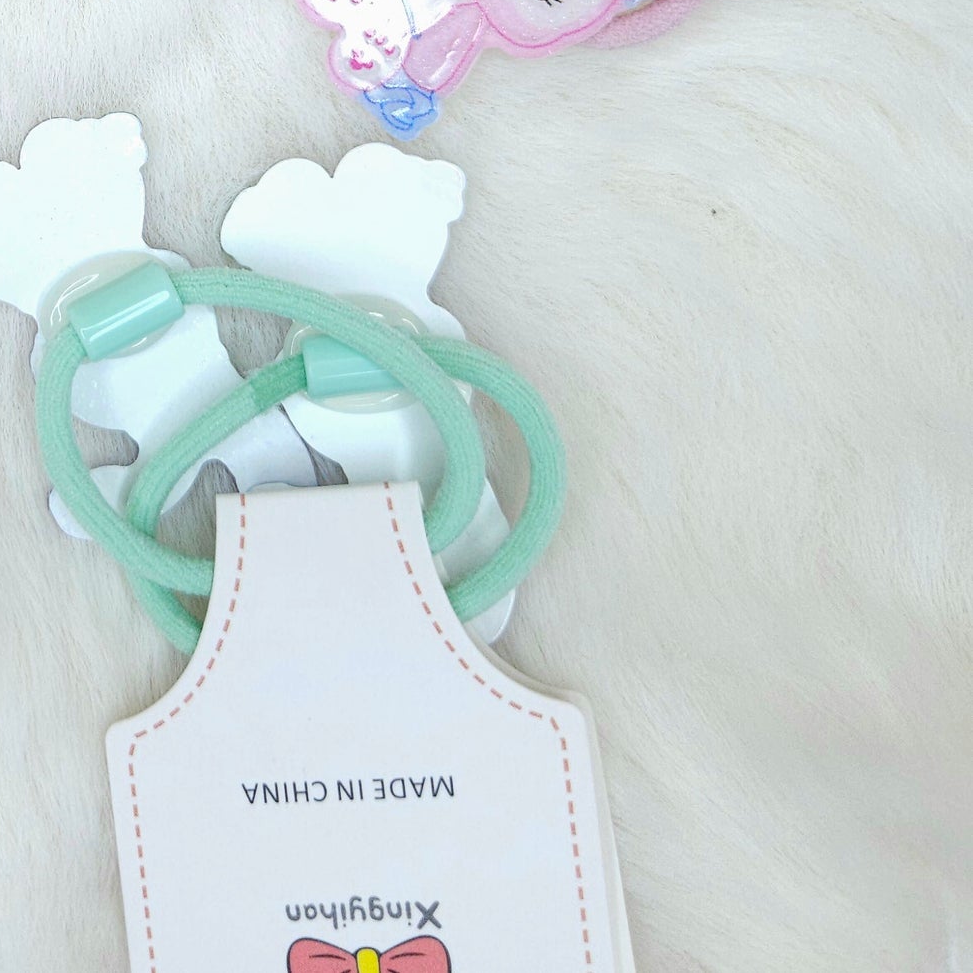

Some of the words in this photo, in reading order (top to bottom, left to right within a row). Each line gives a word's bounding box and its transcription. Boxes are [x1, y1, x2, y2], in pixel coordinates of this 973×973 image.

[241, 780, 328, 804] CHINA
[336, 779, 364, 801] IN
[372, 775, 455, 800] MADE
[285, 895, 442, 930] Xingyihan
